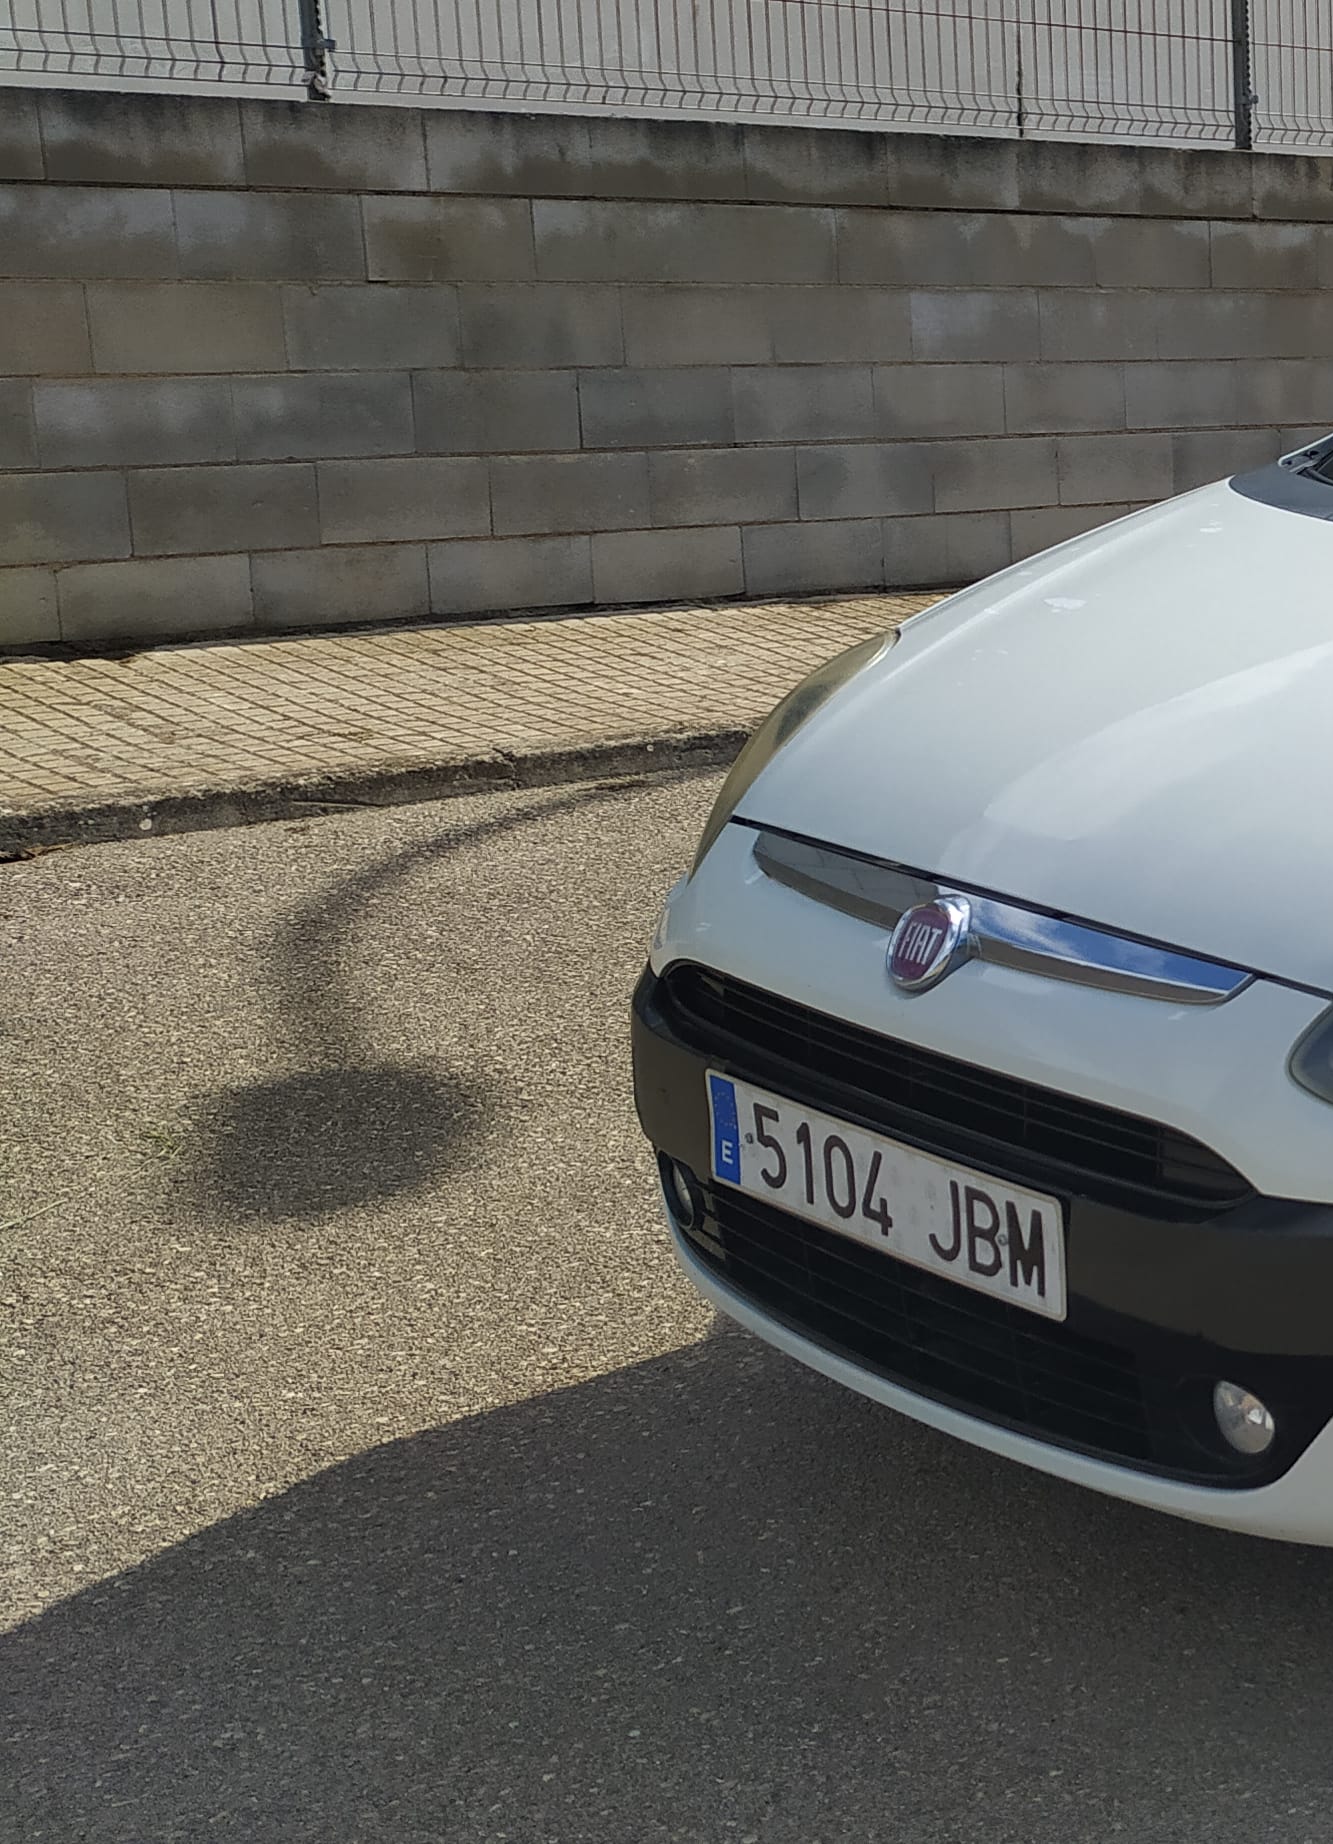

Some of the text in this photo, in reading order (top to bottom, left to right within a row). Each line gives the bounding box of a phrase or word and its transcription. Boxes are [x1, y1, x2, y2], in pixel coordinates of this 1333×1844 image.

[898, 920, 943, 966] FIAT
[721, 1102, 1046, 1299] E 5104 JBM
